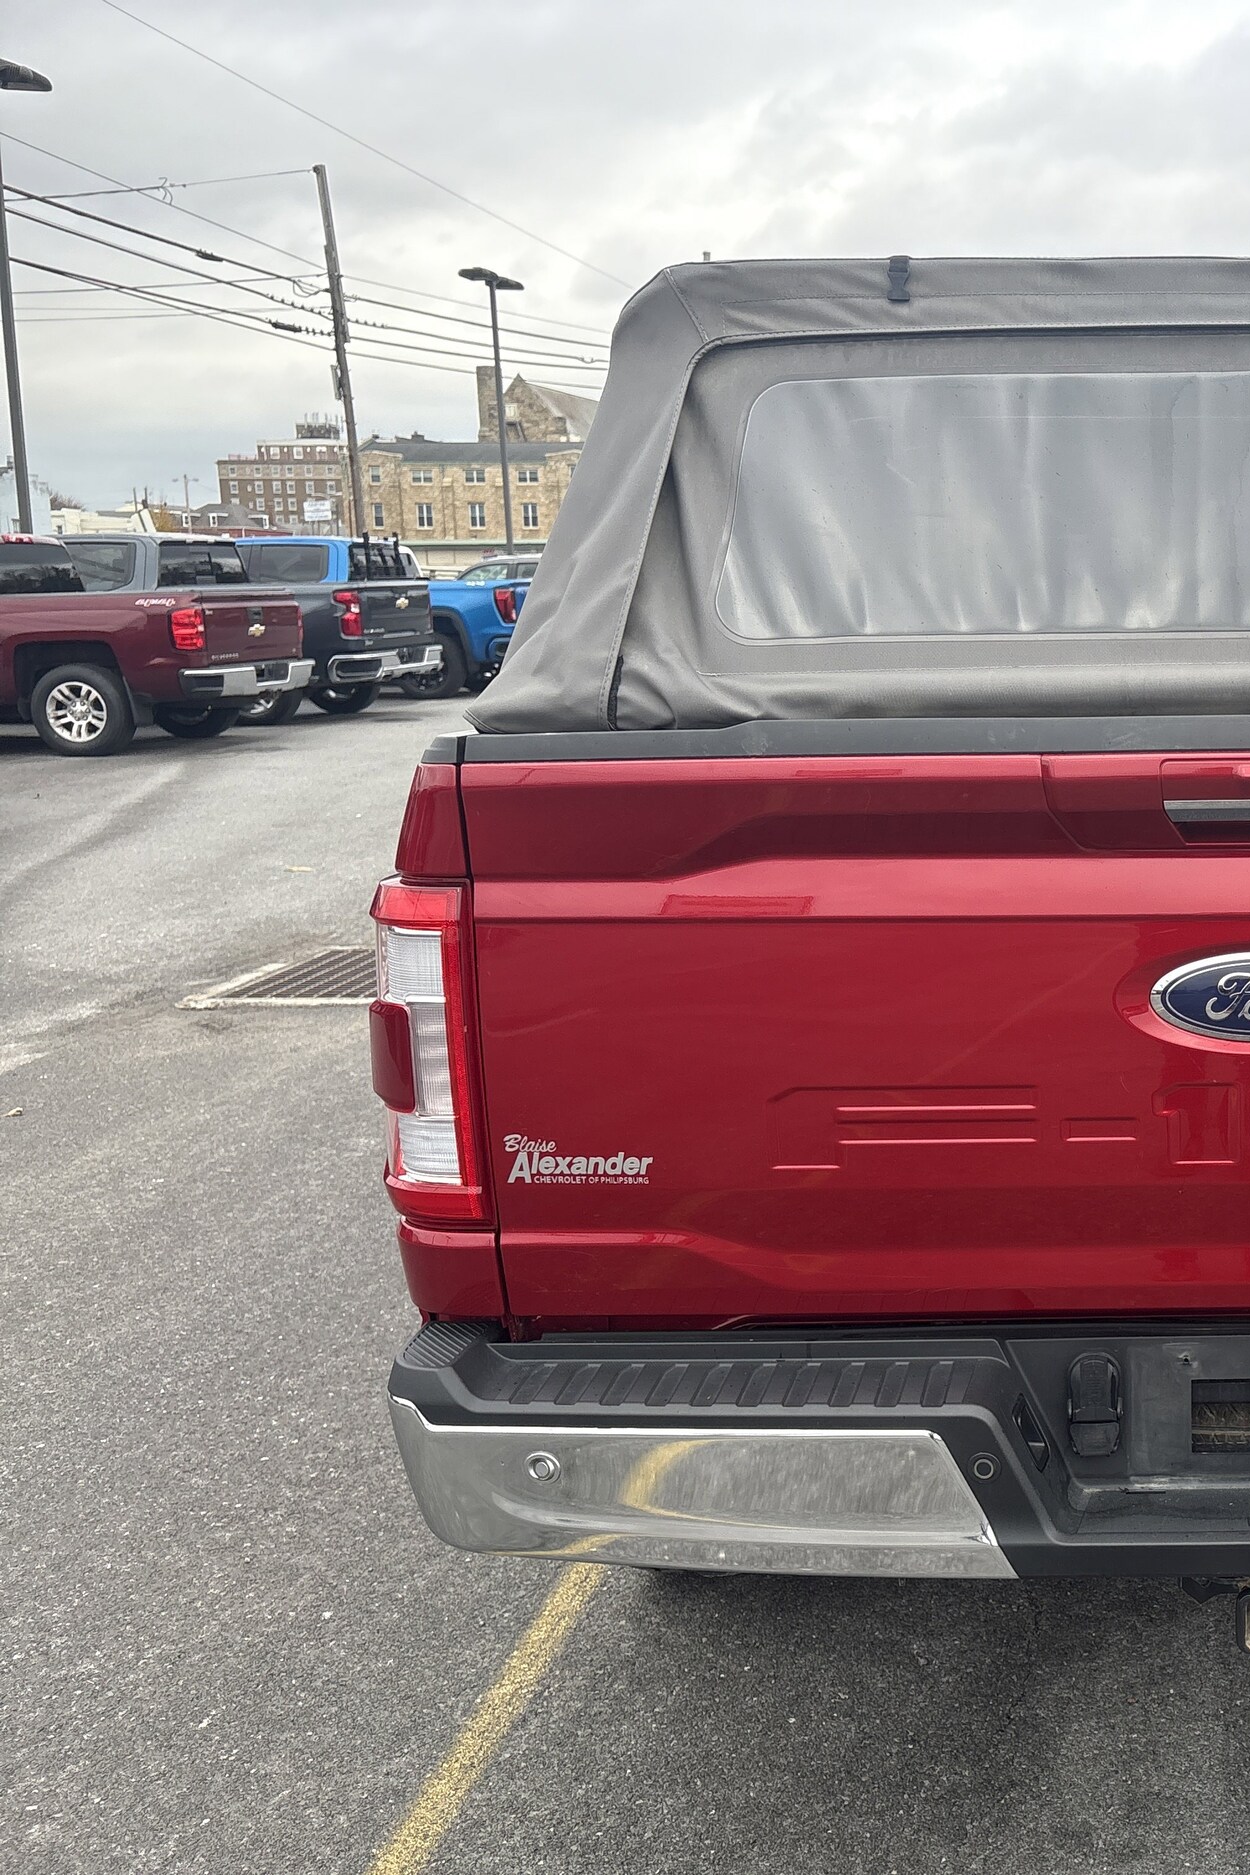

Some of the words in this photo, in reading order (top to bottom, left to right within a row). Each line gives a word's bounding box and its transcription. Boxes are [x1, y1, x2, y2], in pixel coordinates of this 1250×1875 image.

[503, 1134, 557, 1152] Blaise
[507, 1152, 653, 1183] Alexander
[534, 1175, 587, 1184] CHEVROLET
[588, 1176, 599, 1184] OF
[600, 1176, 650, 1185] PHILIPSBURG
